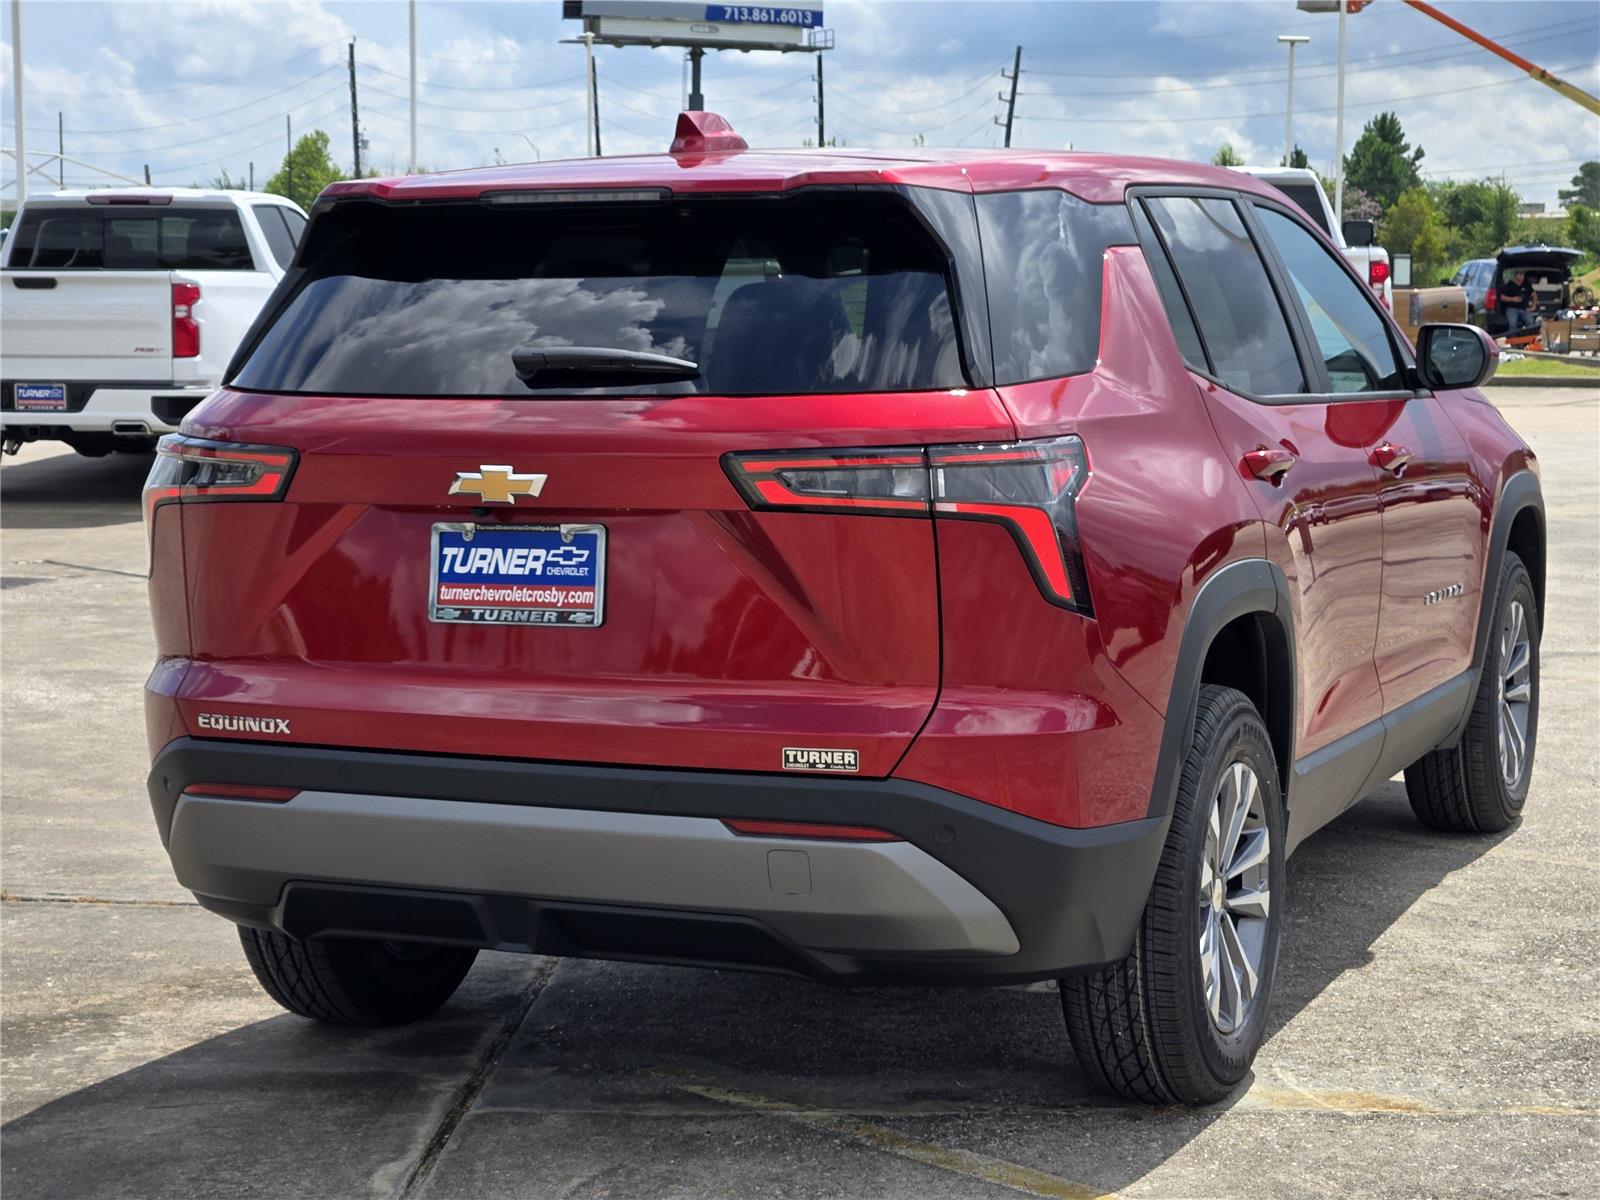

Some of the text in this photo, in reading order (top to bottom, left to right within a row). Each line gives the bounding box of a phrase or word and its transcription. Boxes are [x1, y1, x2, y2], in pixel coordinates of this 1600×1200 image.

[724, 7, 812, 24] 713.861.6013
[18, 388, 49, 398] TURNER
[442, 547, 547, 576] TURNER
[546, 566, 589, 576] CHEVROLET
[440, 585, 594, 607] turnerchevroletcrosby.com
[471, 609, 558, 623] TURNER
[198, 713, 291, 734] EQUINOX
[786, 750, 856, 764] TURNER
